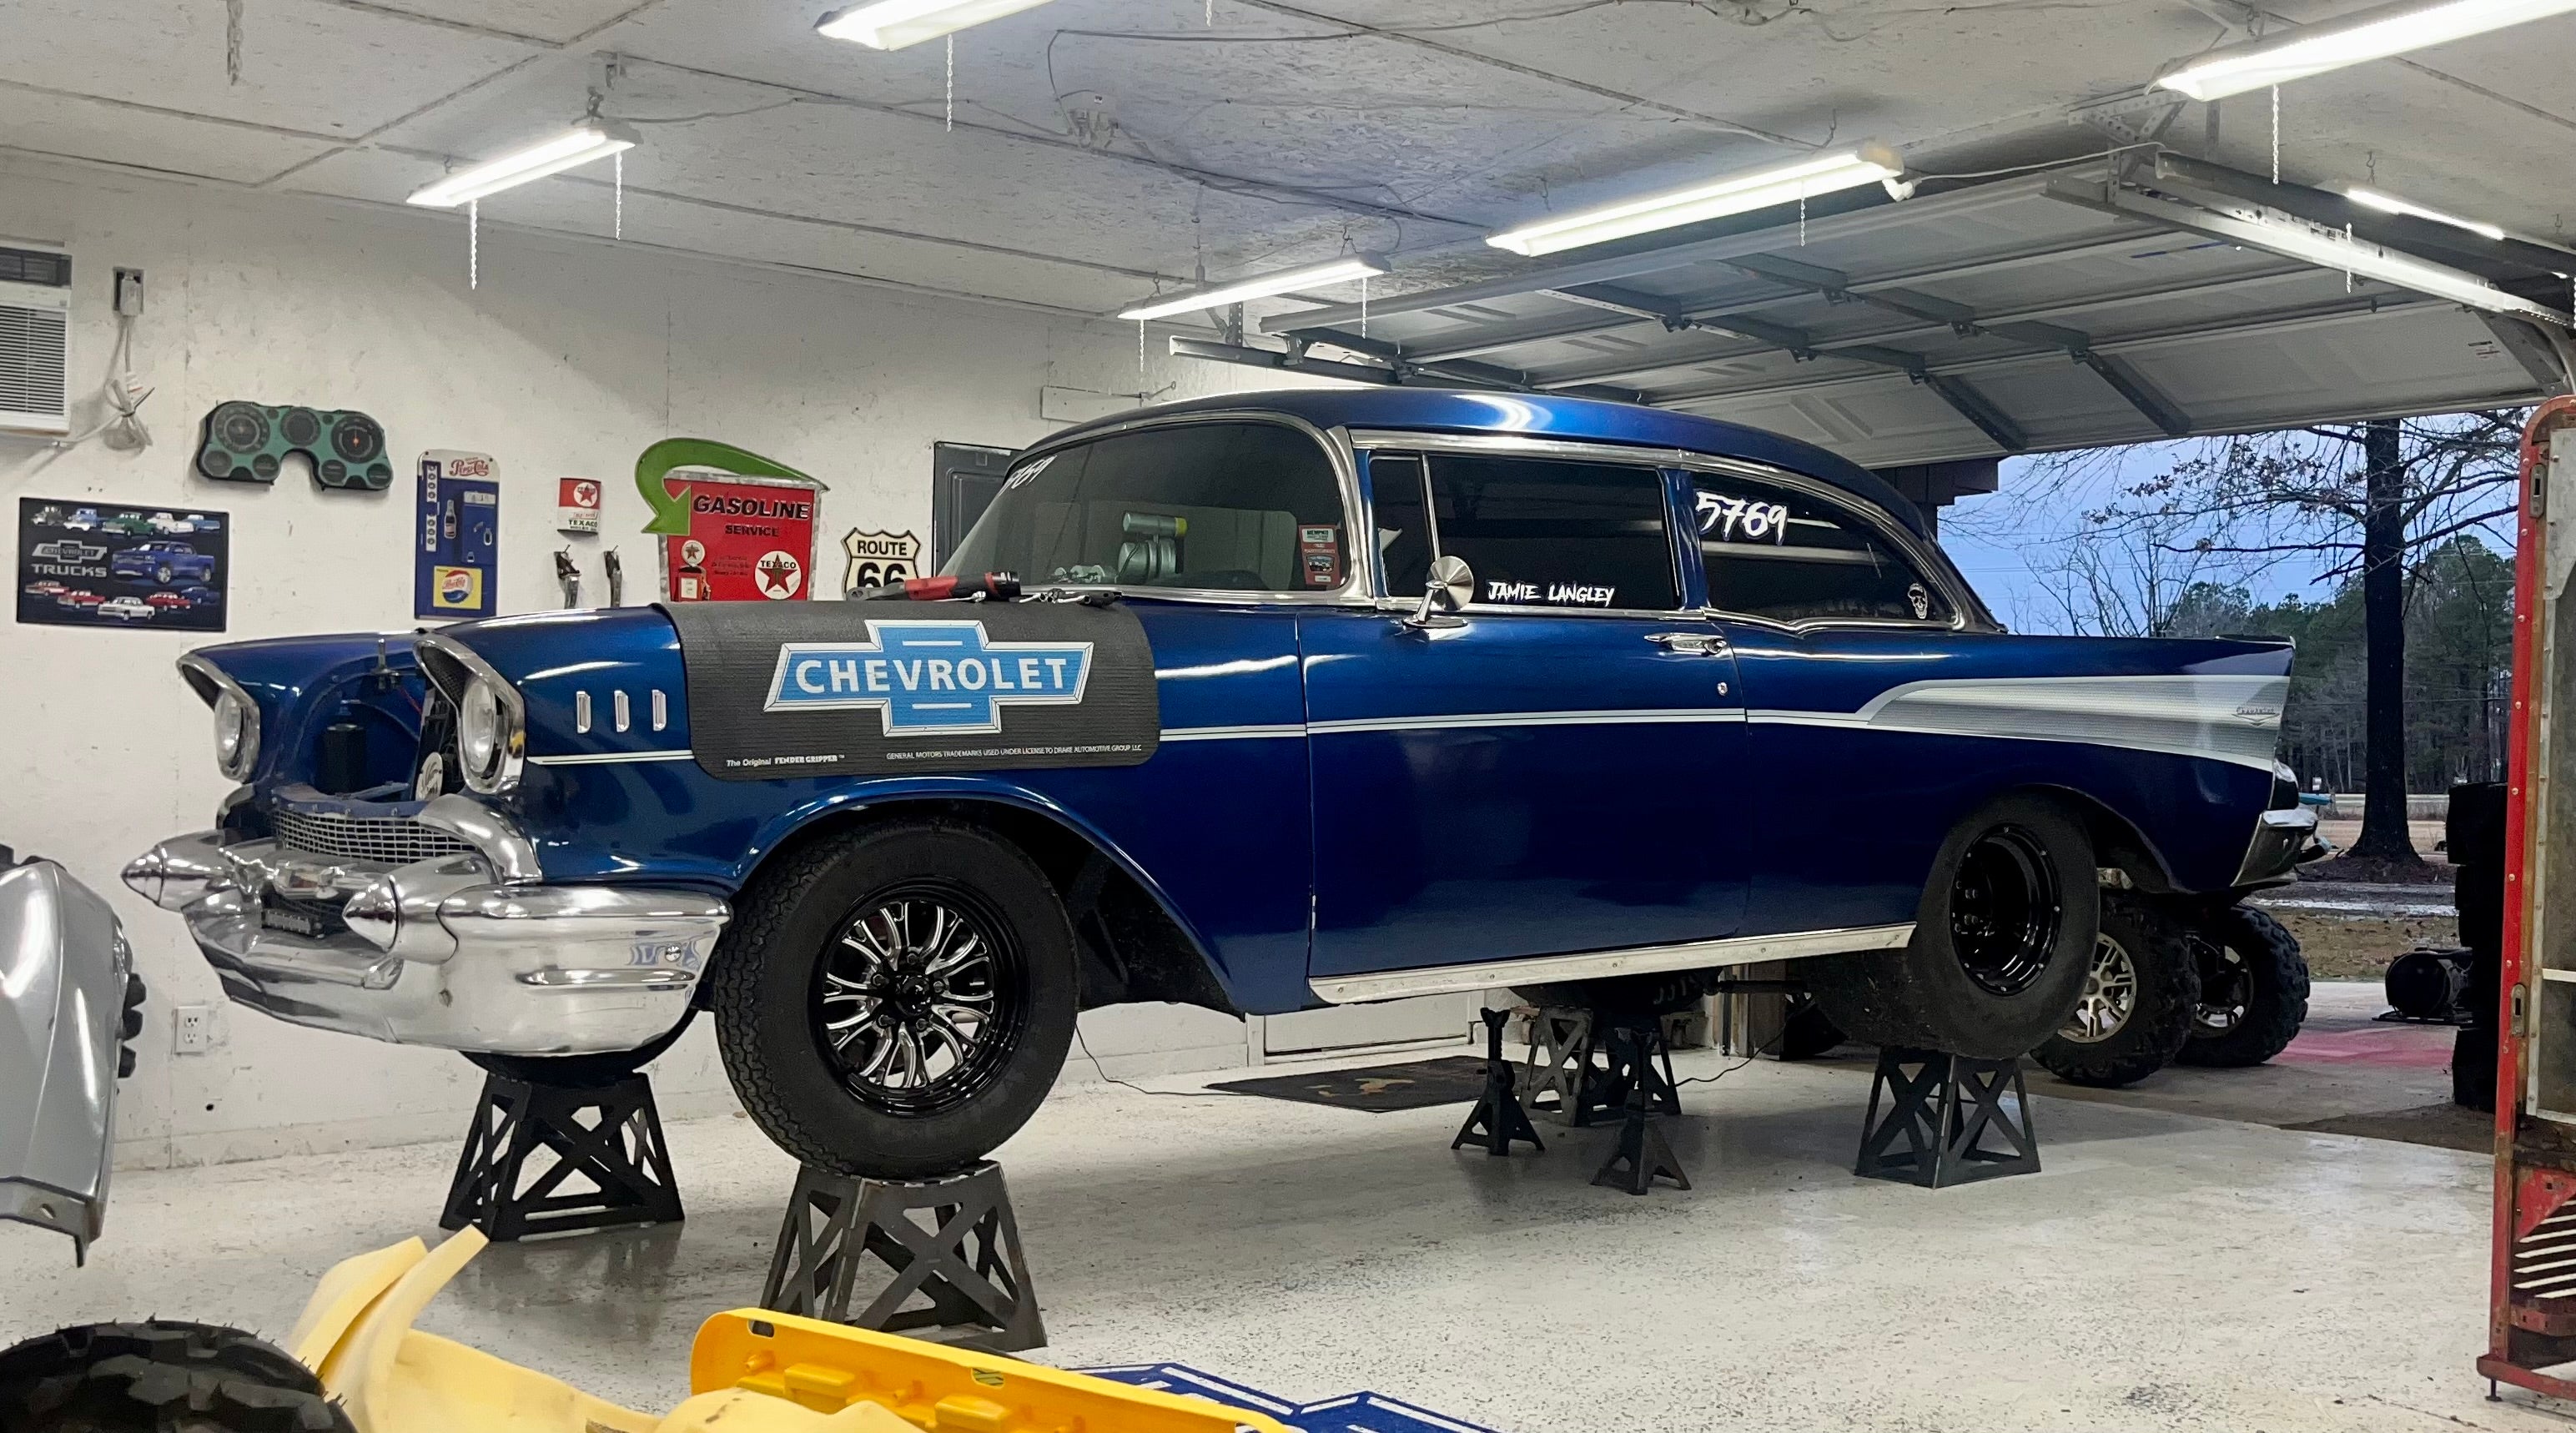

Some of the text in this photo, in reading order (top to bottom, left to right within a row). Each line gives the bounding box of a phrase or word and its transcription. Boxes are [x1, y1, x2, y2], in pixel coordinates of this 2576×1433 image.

[692, 495, 811, 520] GASOLINE
[1695, 491, 1787, 542] 5769
[724, 523, 780, 537] SERVICE
[857, 540, 908, 556] ROUTE
[30, 563, 107, 577] TRUCKS
[761, 560, 797, 569] TEXACO
[1488, 581, 1615, 607] JAMIE LANGLEY
[796, 657, 1066, 693] CHEVROLET
[1074, 745, 1110, 753] AUTOMOTIVE
[742, 758, 772, 767] Original
[806, 755, 838, 763] GRIPPER
